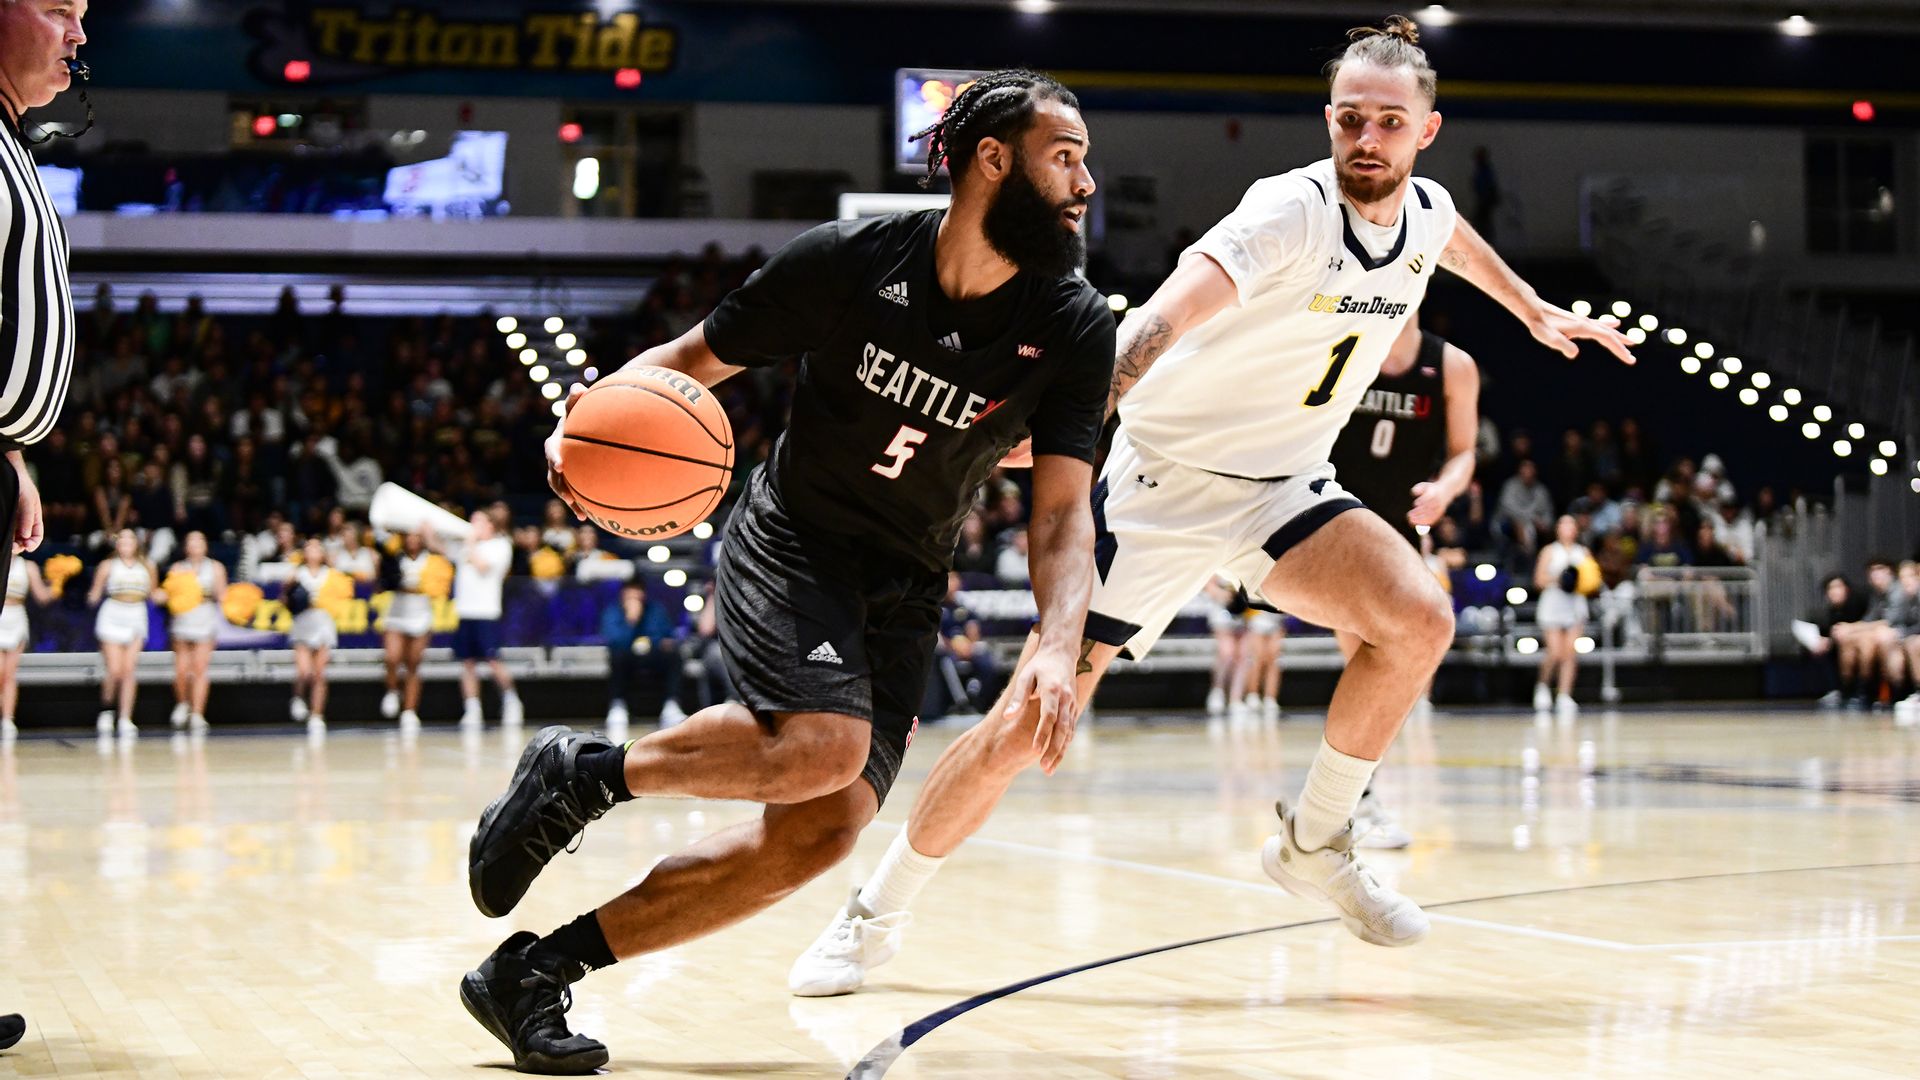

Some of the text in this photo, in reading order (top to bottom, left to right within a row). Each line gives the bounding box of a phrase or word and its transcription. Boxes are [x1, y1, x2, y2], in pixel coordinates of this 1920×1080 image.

[311, 8, 675, 69] Triton Tide
[878, 289, 910, 307] adidas
[1301, 330, 1362, 408] 1
[870, 424, 928, 479] 5
[1370, 419, 1395, 457] 0
[807, 653, 843, 665] adidas
